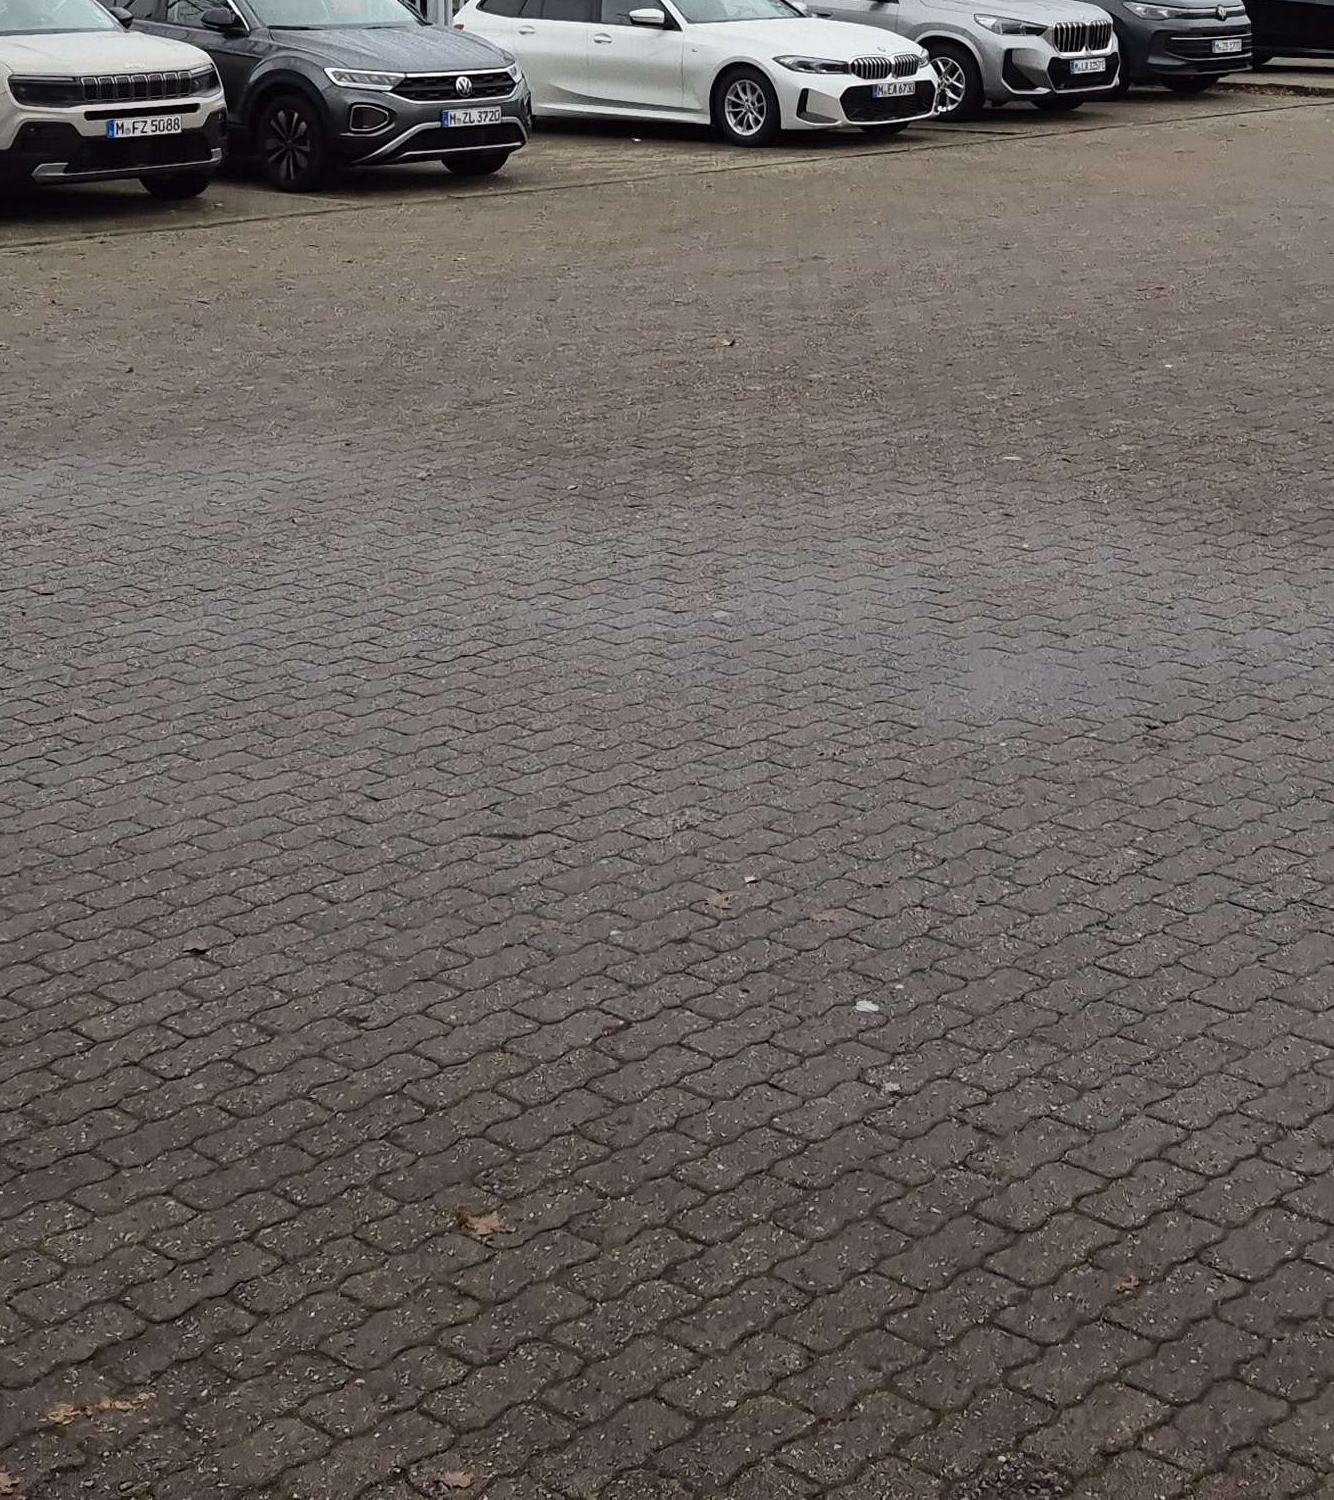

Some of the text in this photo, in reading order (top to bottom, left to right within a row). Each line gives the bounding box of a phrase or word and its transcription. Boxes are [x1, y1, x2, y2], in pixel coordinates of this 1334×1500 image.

[115, 117, 180, 135] M FZ 5088
